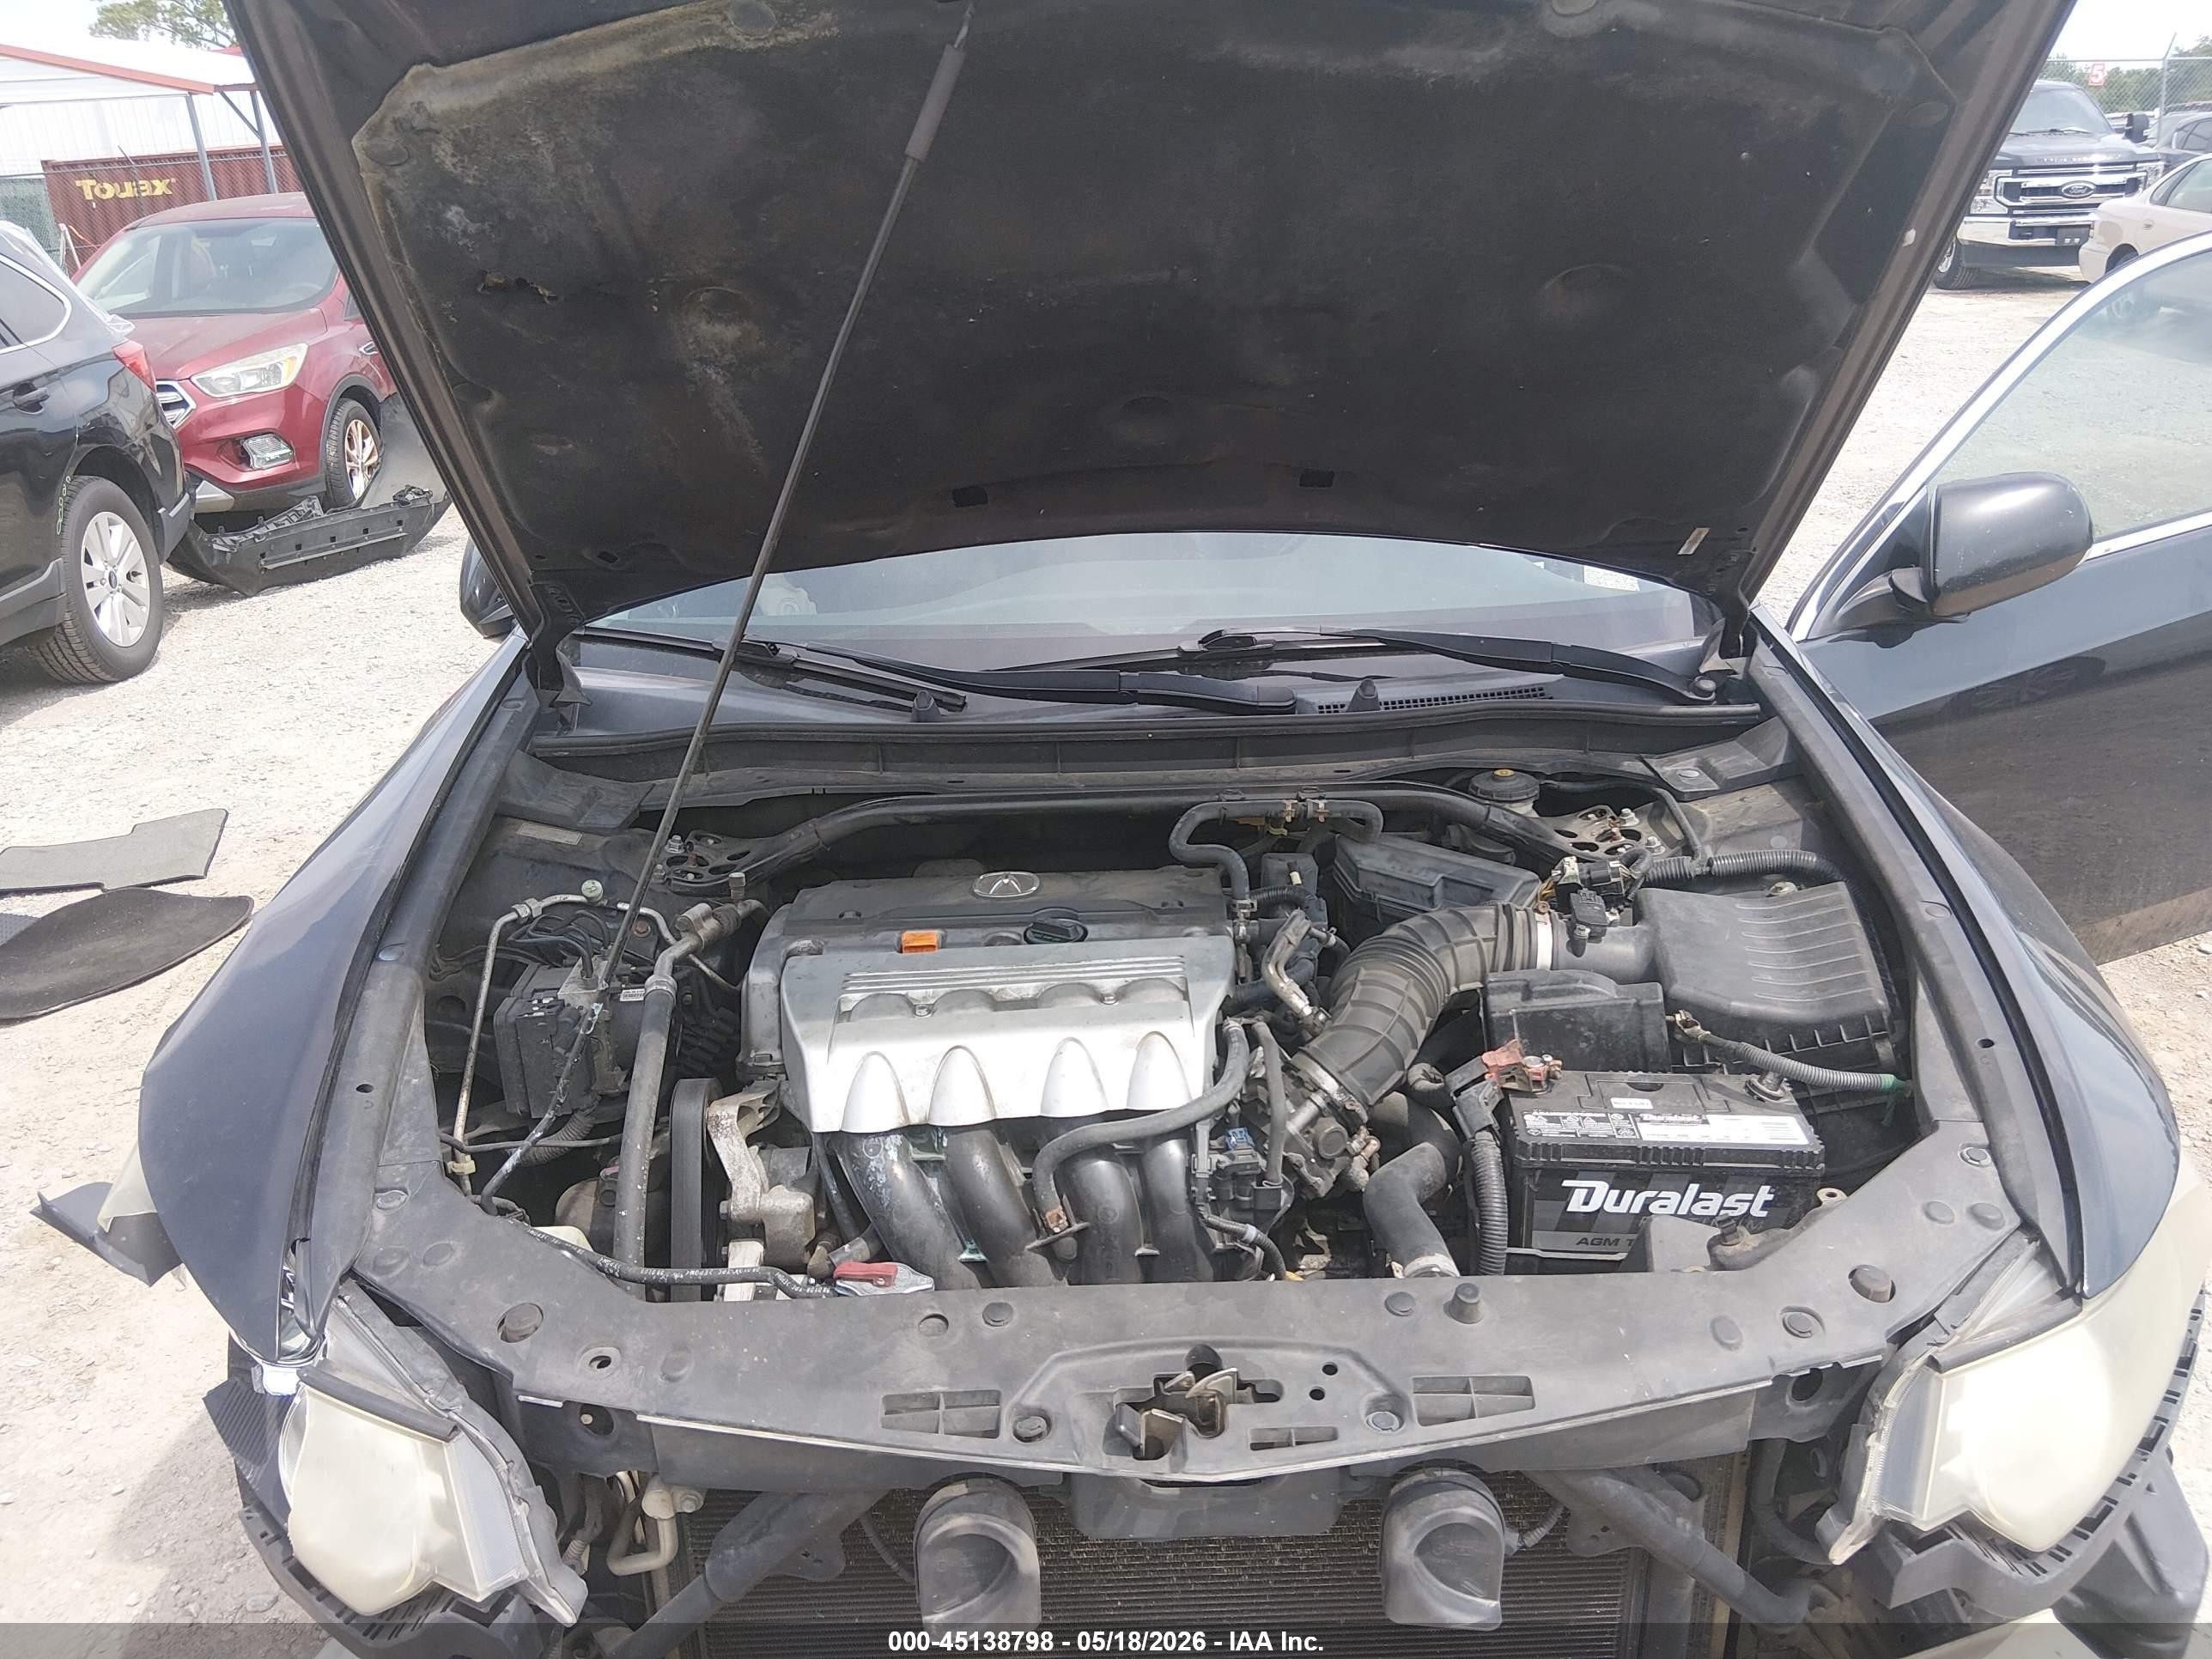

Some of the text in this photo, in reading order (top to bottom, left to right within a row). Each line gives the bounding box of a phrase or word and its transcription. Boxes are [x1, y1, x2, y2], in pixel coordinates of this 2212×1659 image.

[2090, 64, 2104, 83] 5
[1561, 1179, 1776, 1218] Duralast
[1575, 1237, 1620, 1247] AGM
